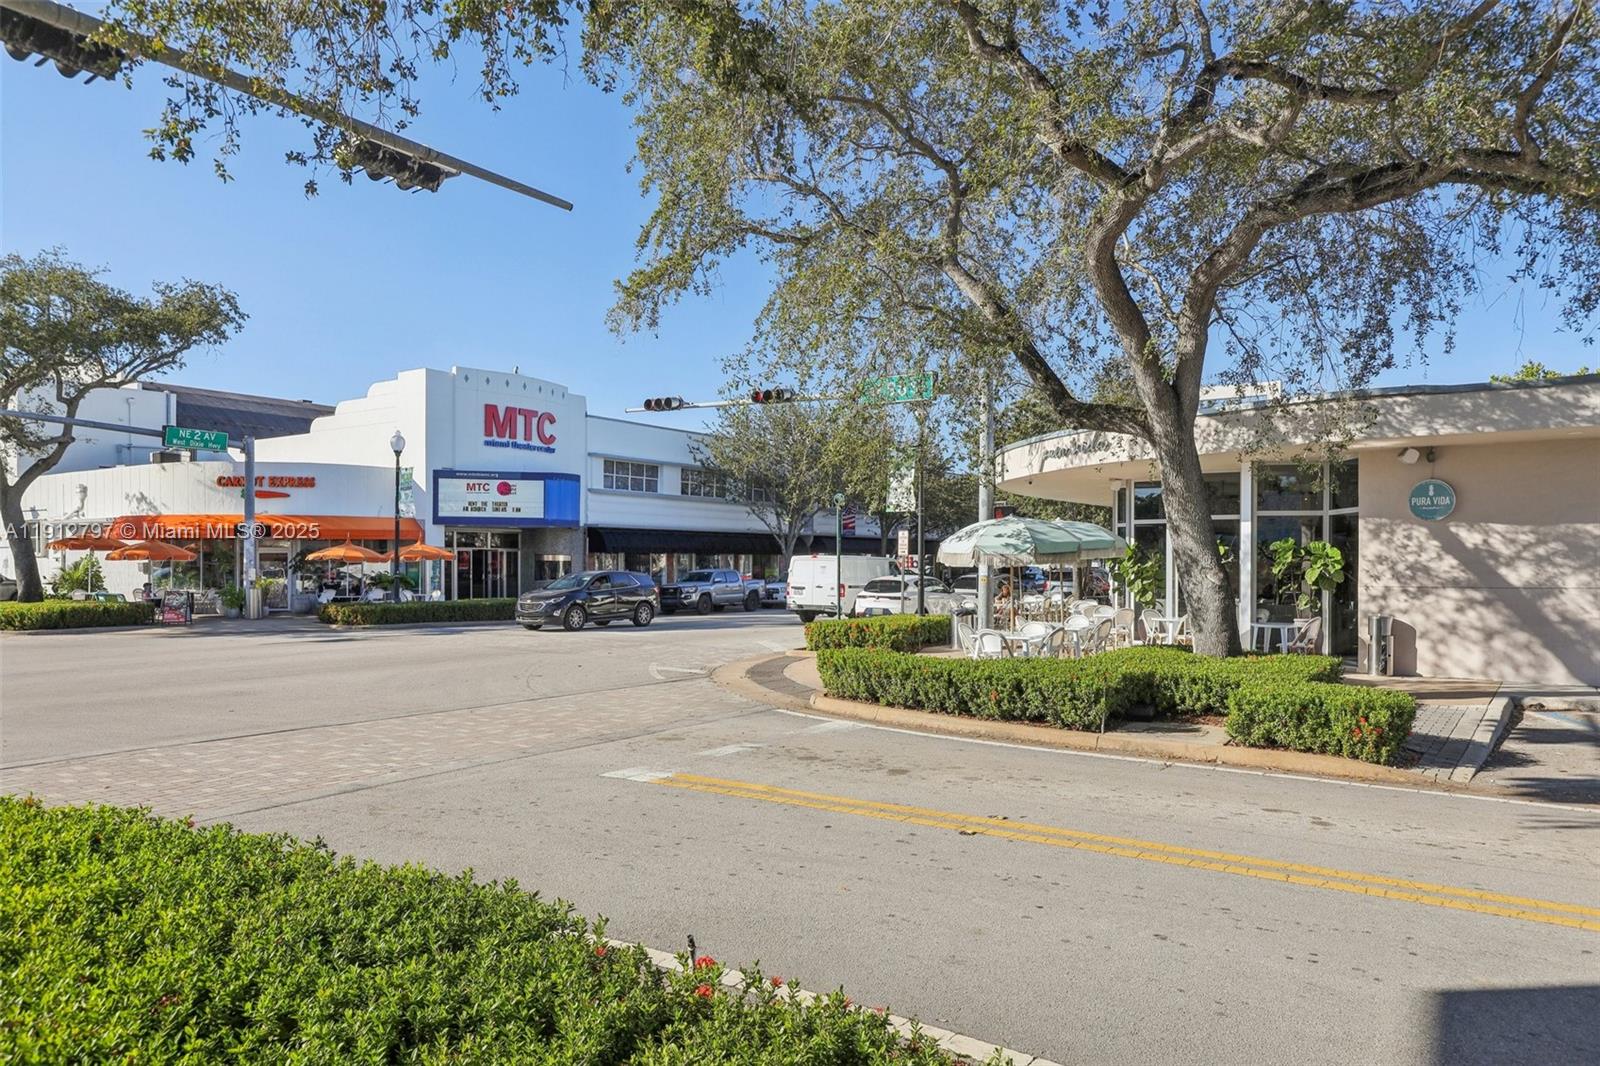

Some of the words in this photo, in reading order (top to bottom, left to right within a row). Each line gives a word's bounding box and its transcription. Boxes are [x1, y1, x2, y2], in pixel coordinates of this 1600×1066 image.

[484, 404, 556, 445] MTC
[179, 430, 191, 439] NE
[193, 430, 201, 440] 2
[203, 431, 216, 441] AV
[268, 476, 315, 488] EXPRESS
[466, 482, 490, 491] MTC
[1411, 496, 1431, 505] PURA
[1432, 496, 1451, 505] VIDA
